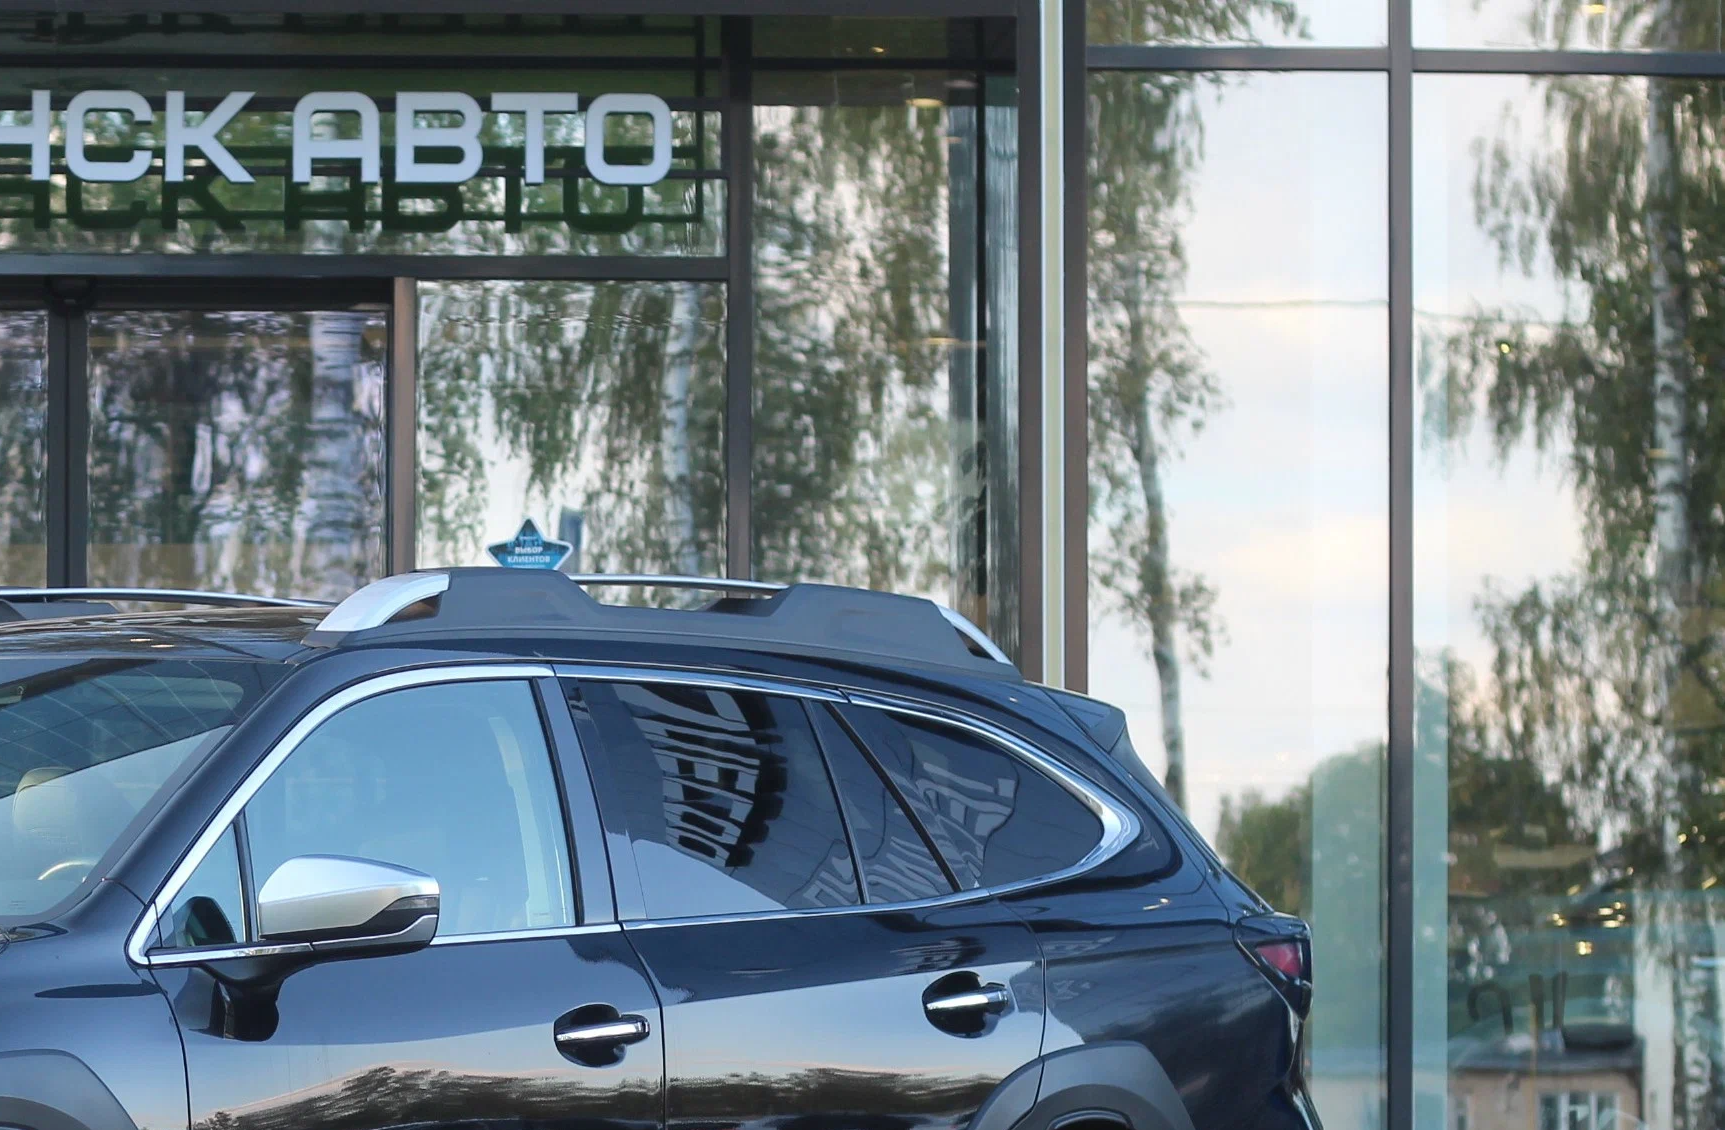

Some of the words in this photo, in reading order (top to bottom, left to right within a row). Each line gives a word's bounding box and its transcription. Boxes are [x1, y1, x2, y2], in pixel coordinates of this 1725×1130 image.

[292, 91, 673, 185] АВТО
[515, 546, 543, 554] ВЫБОР
[507, 555, 550, 563] КЛИЕНТОВ
